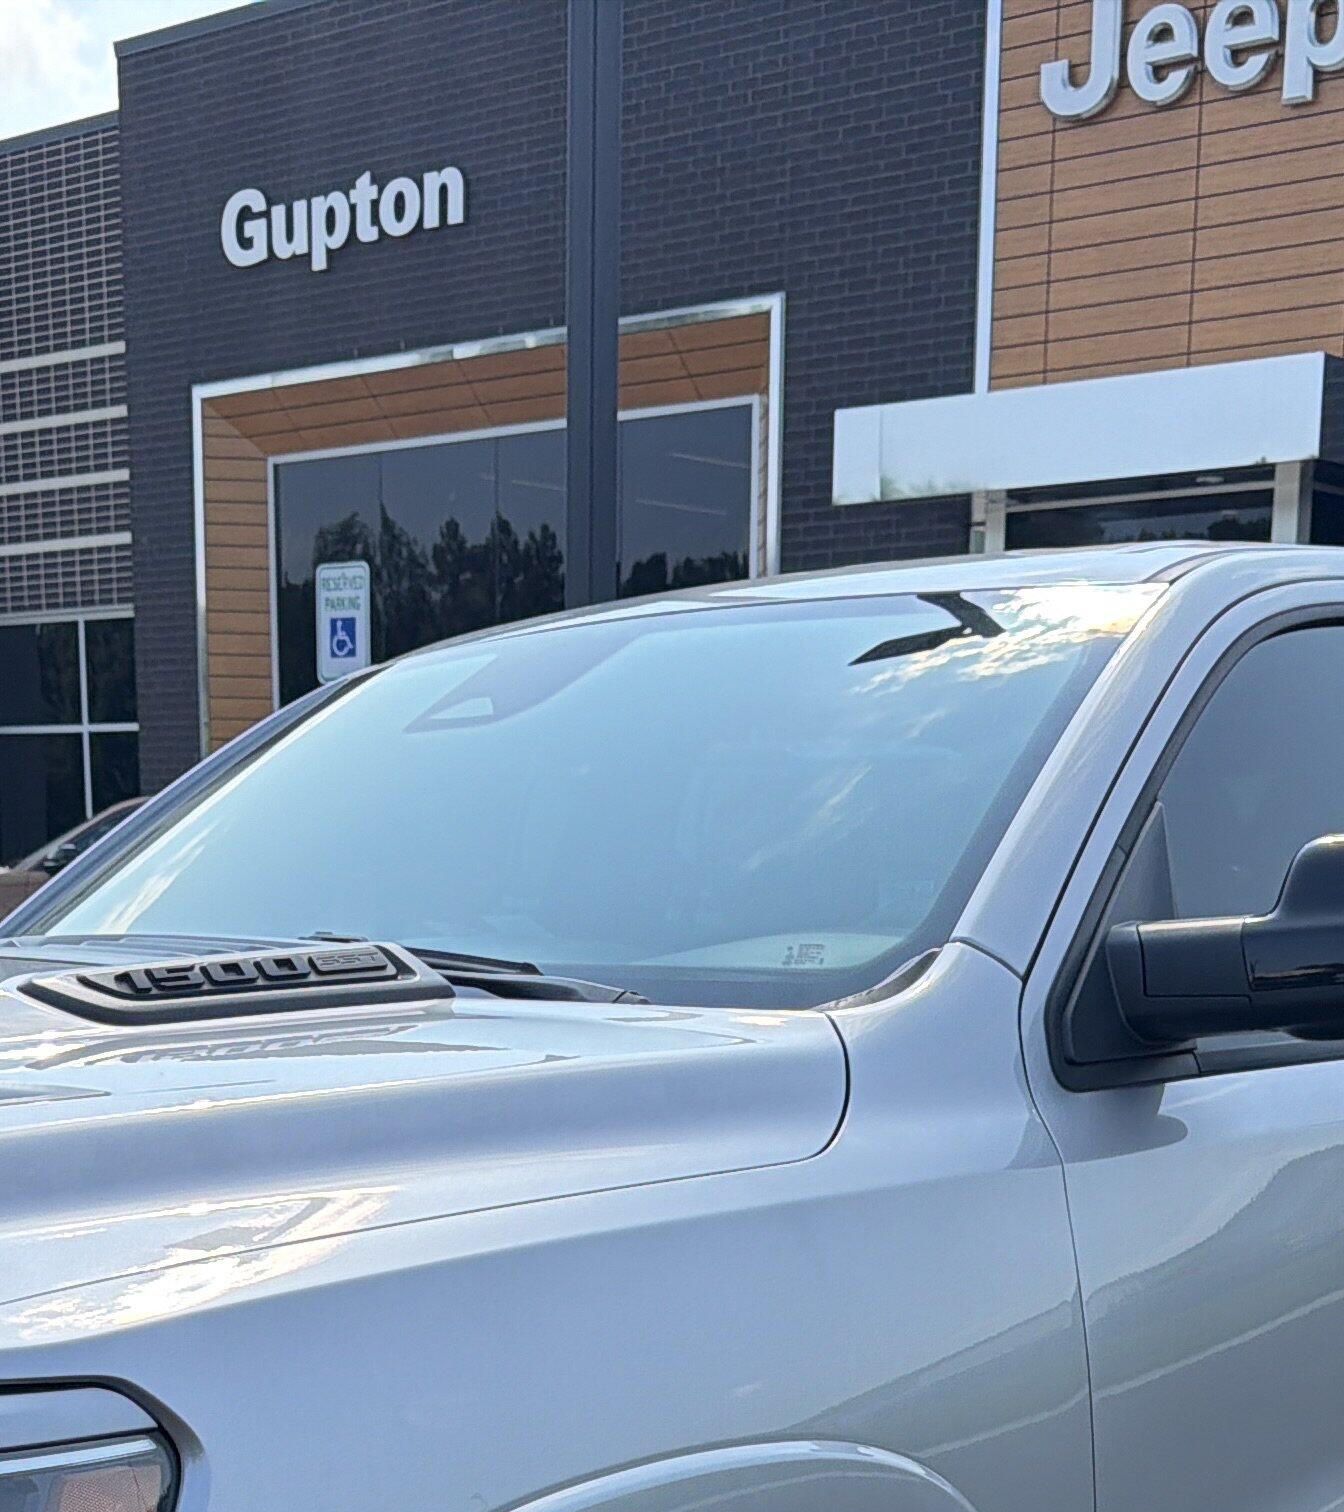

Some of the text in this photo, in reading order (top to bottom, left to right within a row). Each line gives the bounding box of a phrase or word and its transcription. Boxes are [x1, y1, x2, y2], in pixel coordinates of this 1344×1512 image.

[220, 166, 465, 272] Gupton
[321, 573, 364, 592] RESERVED
[324, 596, 361, 611] PARKING
[114, 957, 312, 993] 1500
